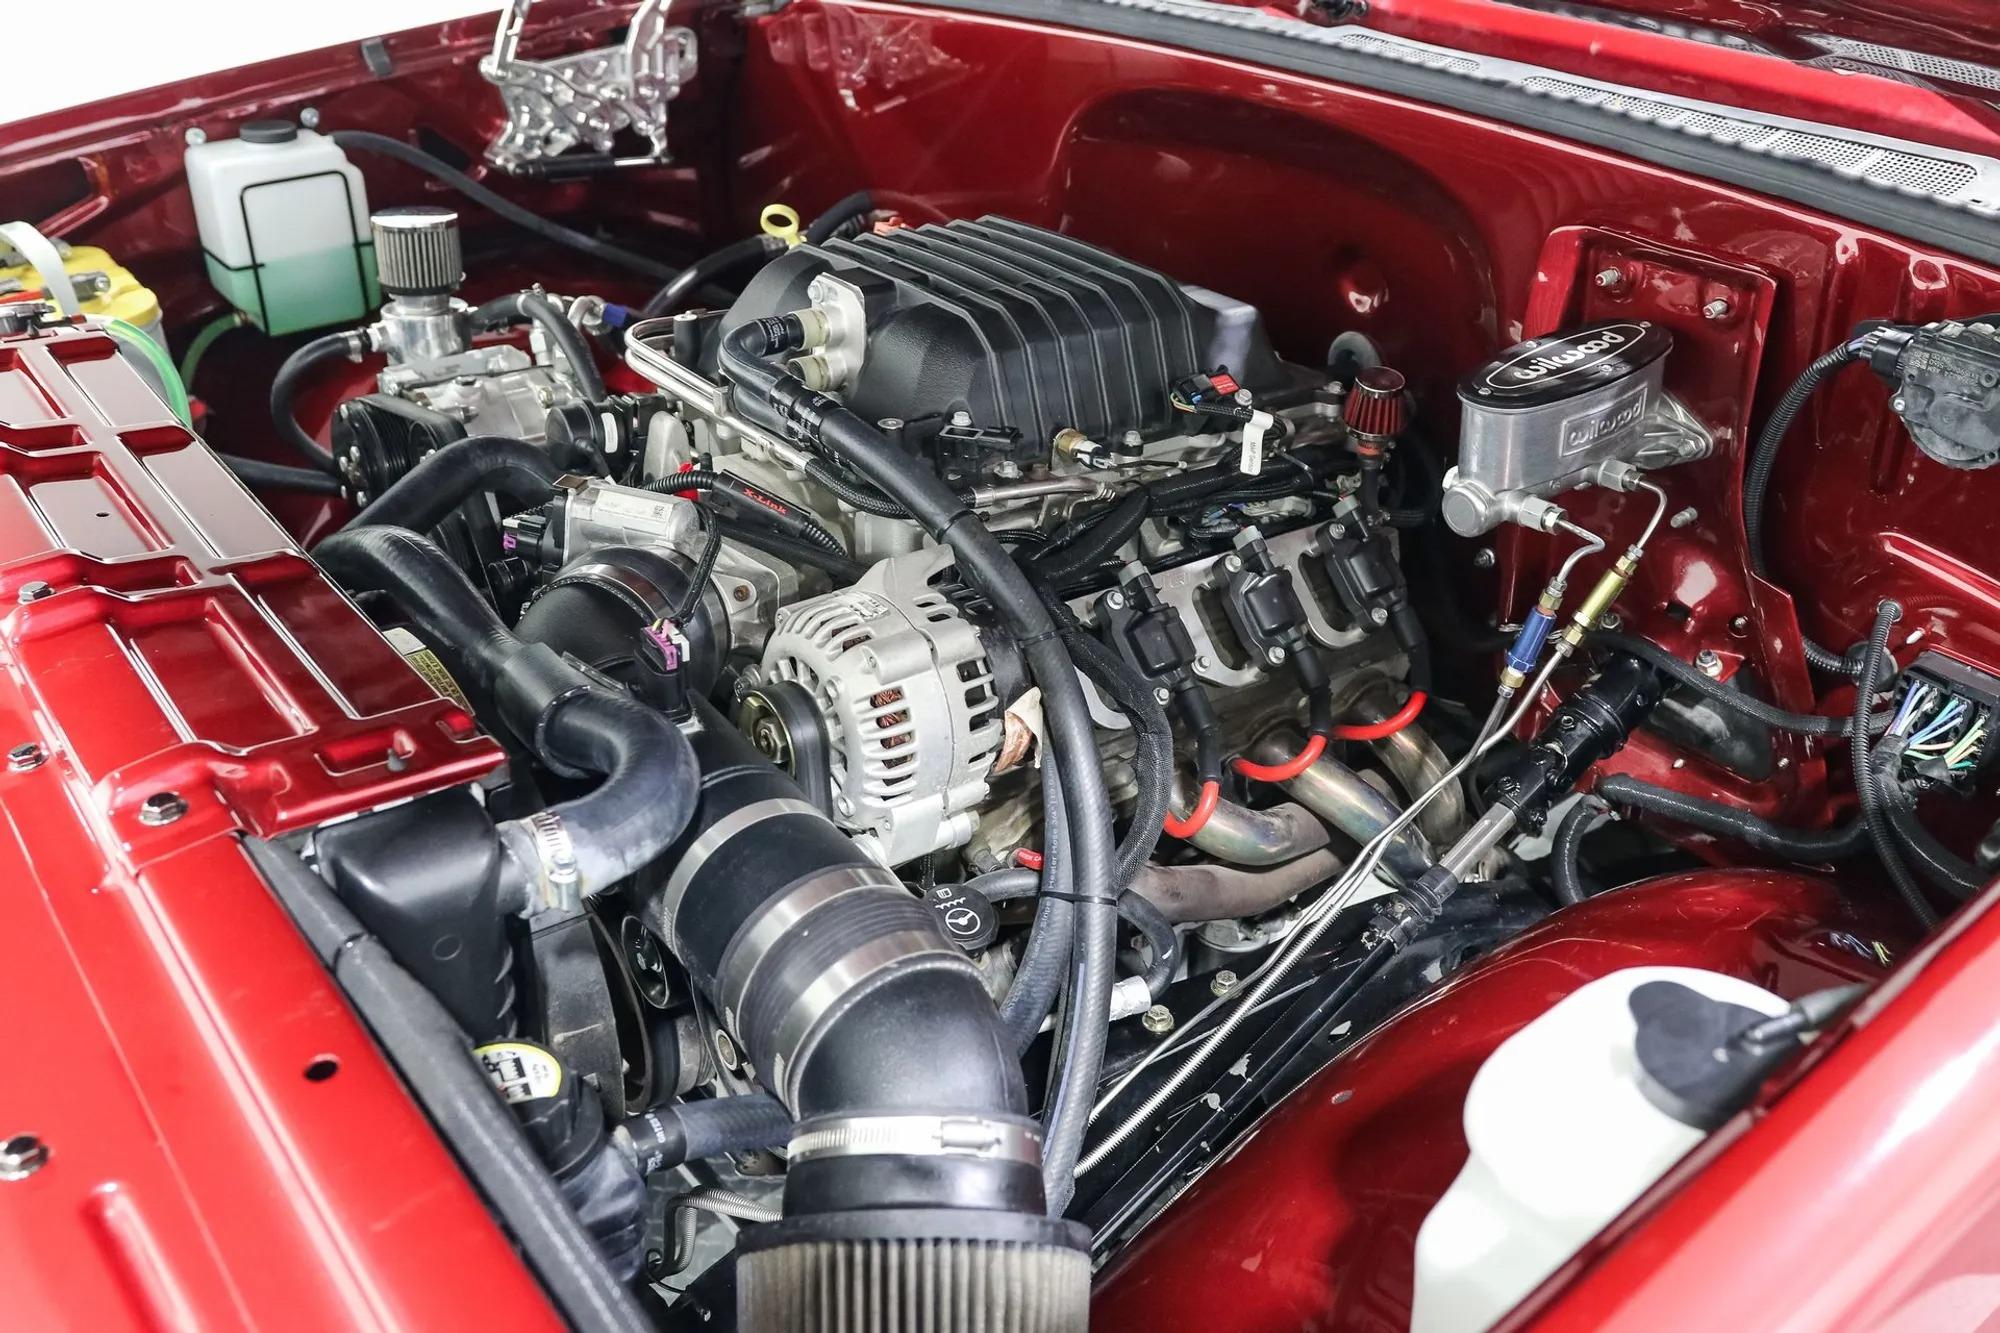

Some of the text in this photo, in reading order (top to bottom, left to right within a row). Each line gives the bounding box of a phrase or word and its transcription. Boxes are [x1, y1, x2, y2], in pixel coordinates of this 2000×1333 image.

[1513, 331, 1626, 380] wilwood
[1569, 397, 1642, 446] wilwood
[743, 487, 787, 515] X-Link
[1048, 856, 1057, 889] Heater
